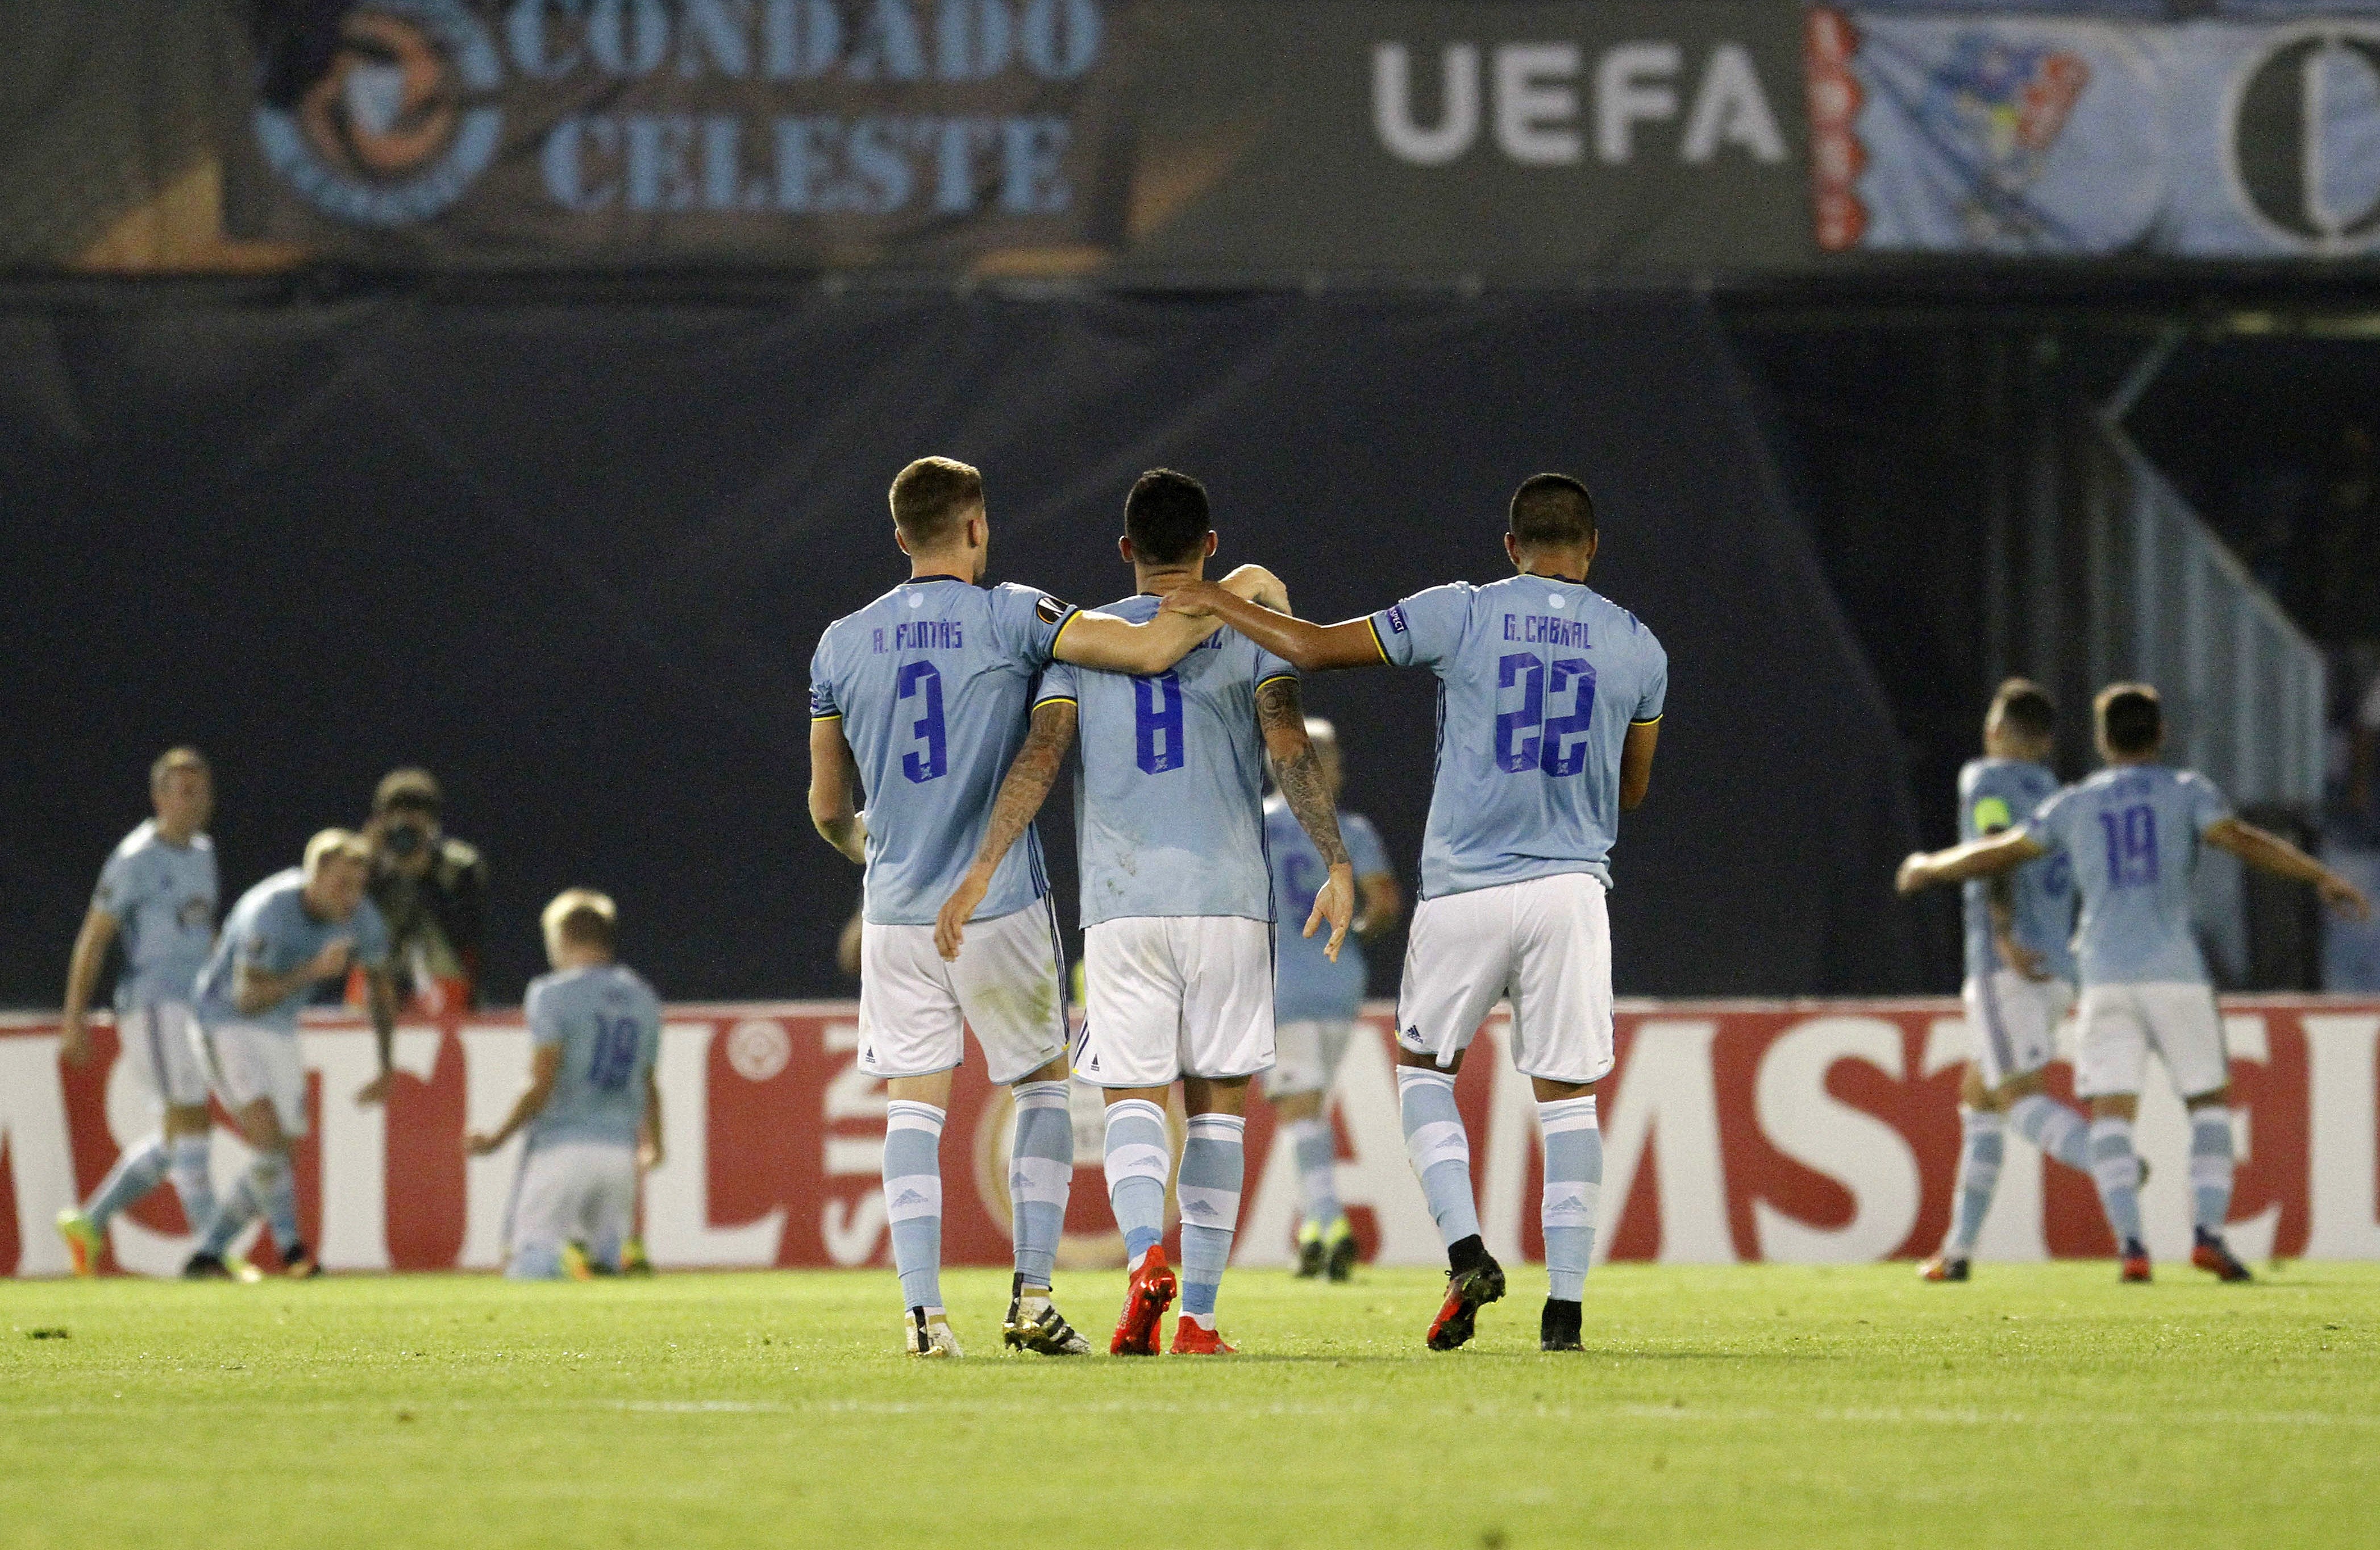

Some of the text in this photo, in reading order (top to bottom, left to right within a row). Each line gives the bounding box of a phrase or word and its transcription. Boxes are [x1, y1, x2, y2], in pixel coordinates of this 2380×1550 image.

[507, 0, 1102, 80] CONDADO
[1371, 41, 1786, 164] UEFA
[541, 115, 1072, 214] CELESTE
[1388, 606, 1405, 631] SPECT
[1525, 615, 1593, 649] CABRAL
[898, 660, 947, 783] 3
[1496, 652, 1596, 777] 22
[2098, 803, 2158, 884] 19
